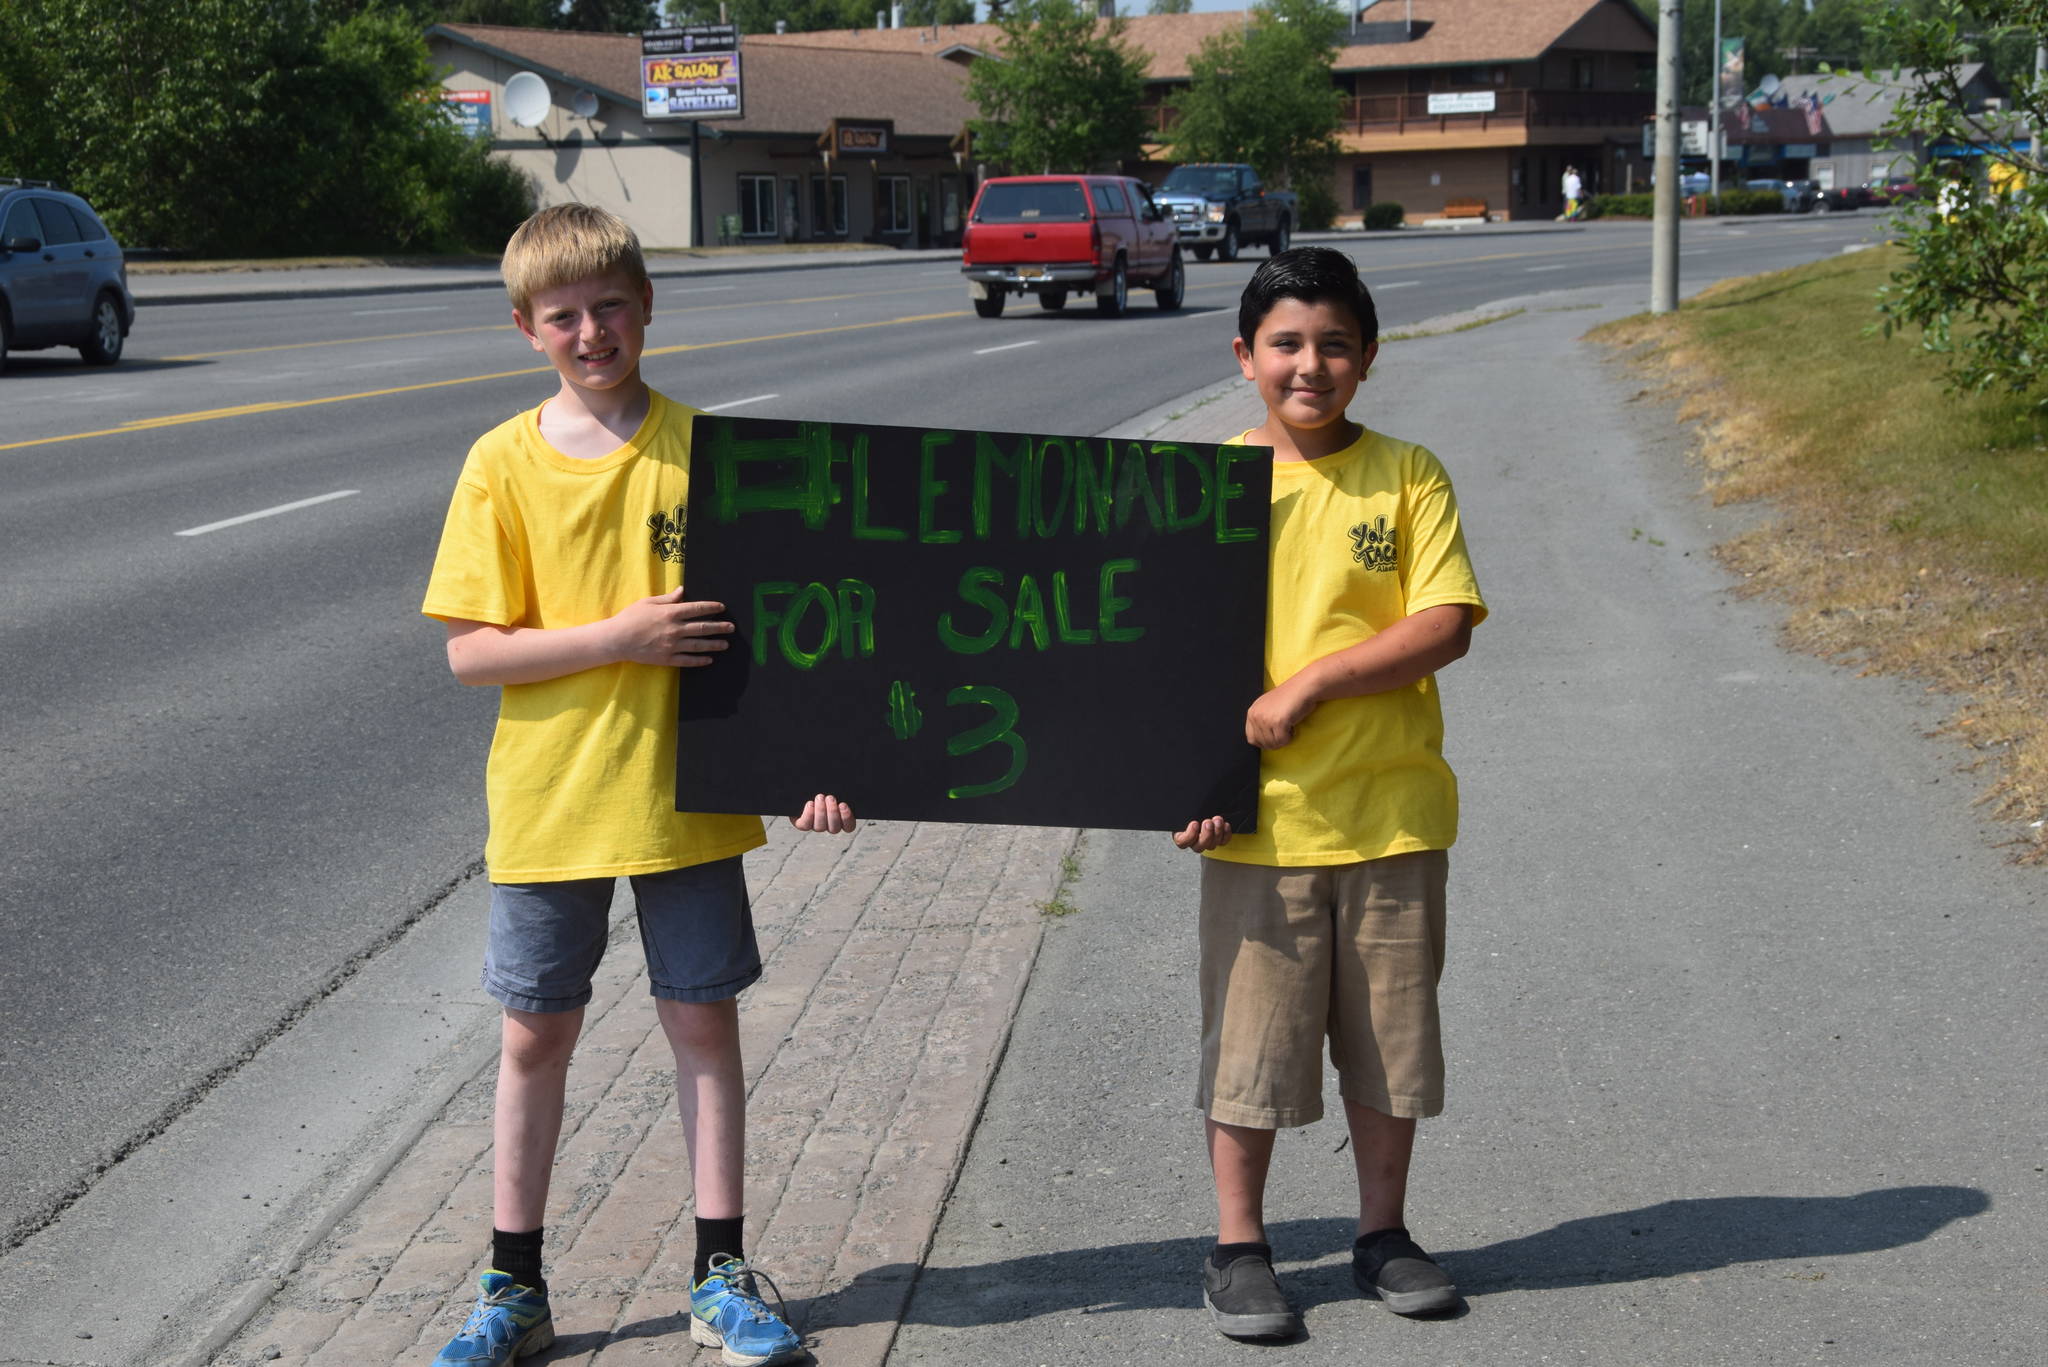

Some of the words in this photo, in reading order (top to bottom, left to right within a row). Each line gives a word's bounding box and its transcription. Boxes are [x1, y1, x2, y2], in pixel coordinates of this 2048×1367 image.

[653, 64, 672, 81] AK
[674, 63, 718, 78] SALON
[669, 94, 737, 110] SATELLITE
[652, 536, 687, 562] TAC
[752, 578, 876, 669] FOR
[937, 558, 1146, 654] SALE
